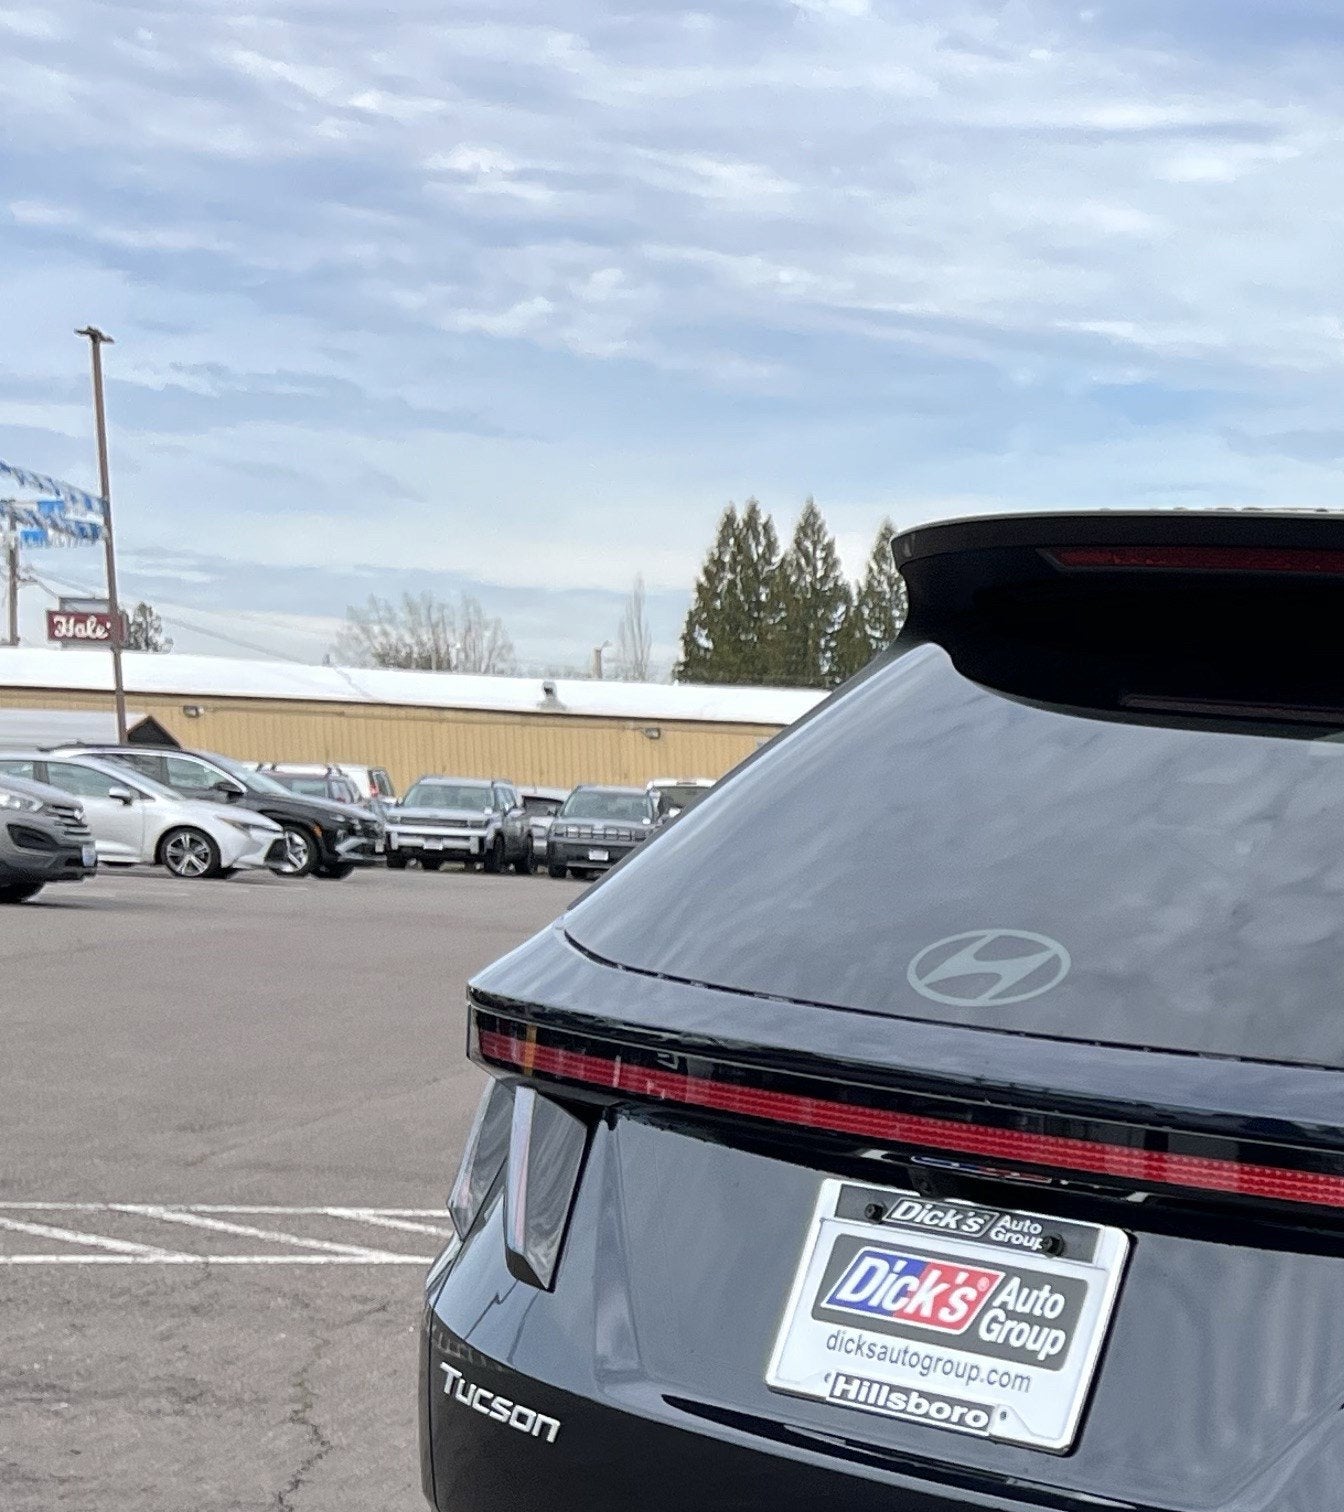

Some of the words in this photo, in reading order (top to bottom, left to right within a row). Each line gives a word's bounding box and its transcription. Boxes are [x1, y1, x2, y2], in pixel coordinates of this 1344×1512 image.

[53, 615, 112, 639] Hale'
[892, 1201, 986, 1233] Dick's
[997, 1214, 1042, 1235] Auto
[837, 1256, 978, 1323] Dick's
[993, 1277, 1065, 1319] Auto
[979, 1308, 1066, 1361] Group
[826, 1330, 1032, 1394] dicksautogroup.com
[440, 1361, 561, 1443] Tucson
[829, 1373, 989, 1428] Hillsboro
